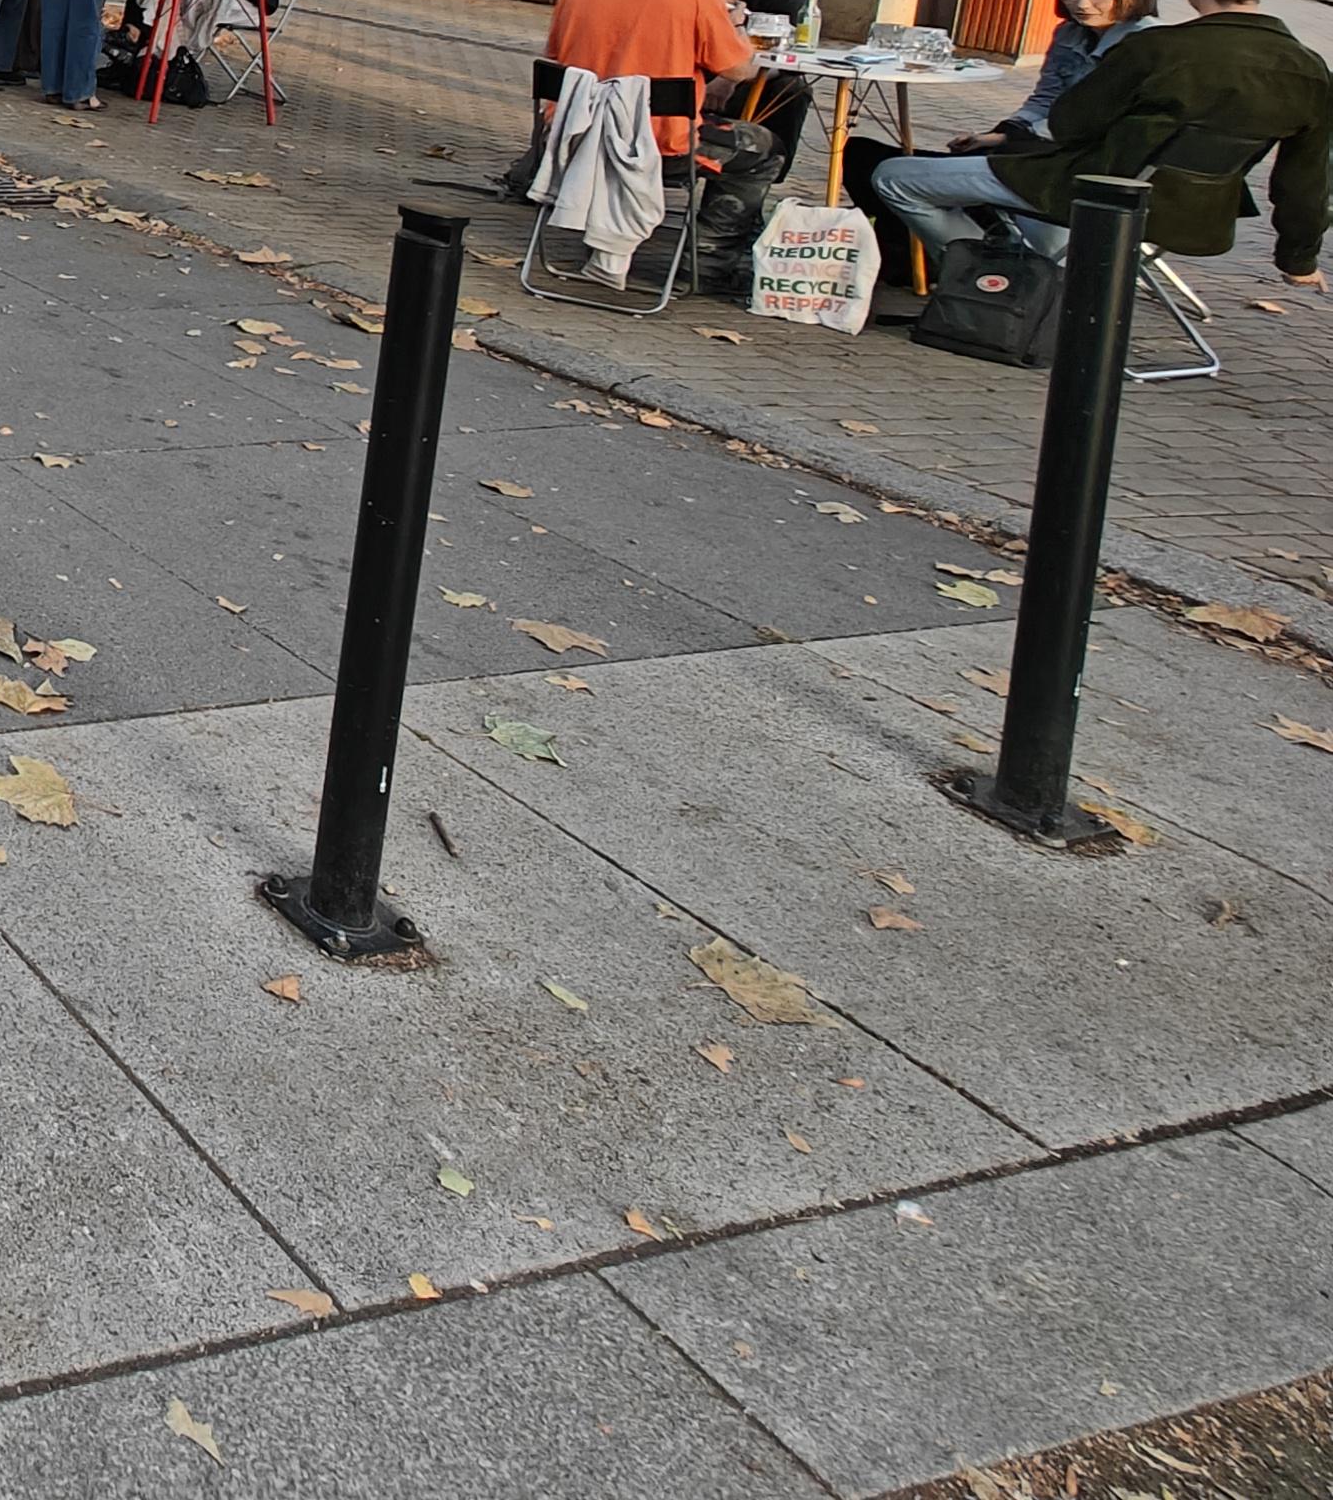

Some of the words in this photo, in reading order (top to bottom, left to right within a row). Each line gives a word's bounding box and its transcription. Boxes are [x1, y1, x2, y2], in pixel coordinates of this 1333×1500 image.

[780, 228, 855, 244] REUSE
[769, 246, 860, 263] REDUCE
[773, 261, 852, 280] DANCE
[760, 276, 857, 300] RECYCLE
[764, 294, 847, 313] REPEAT
